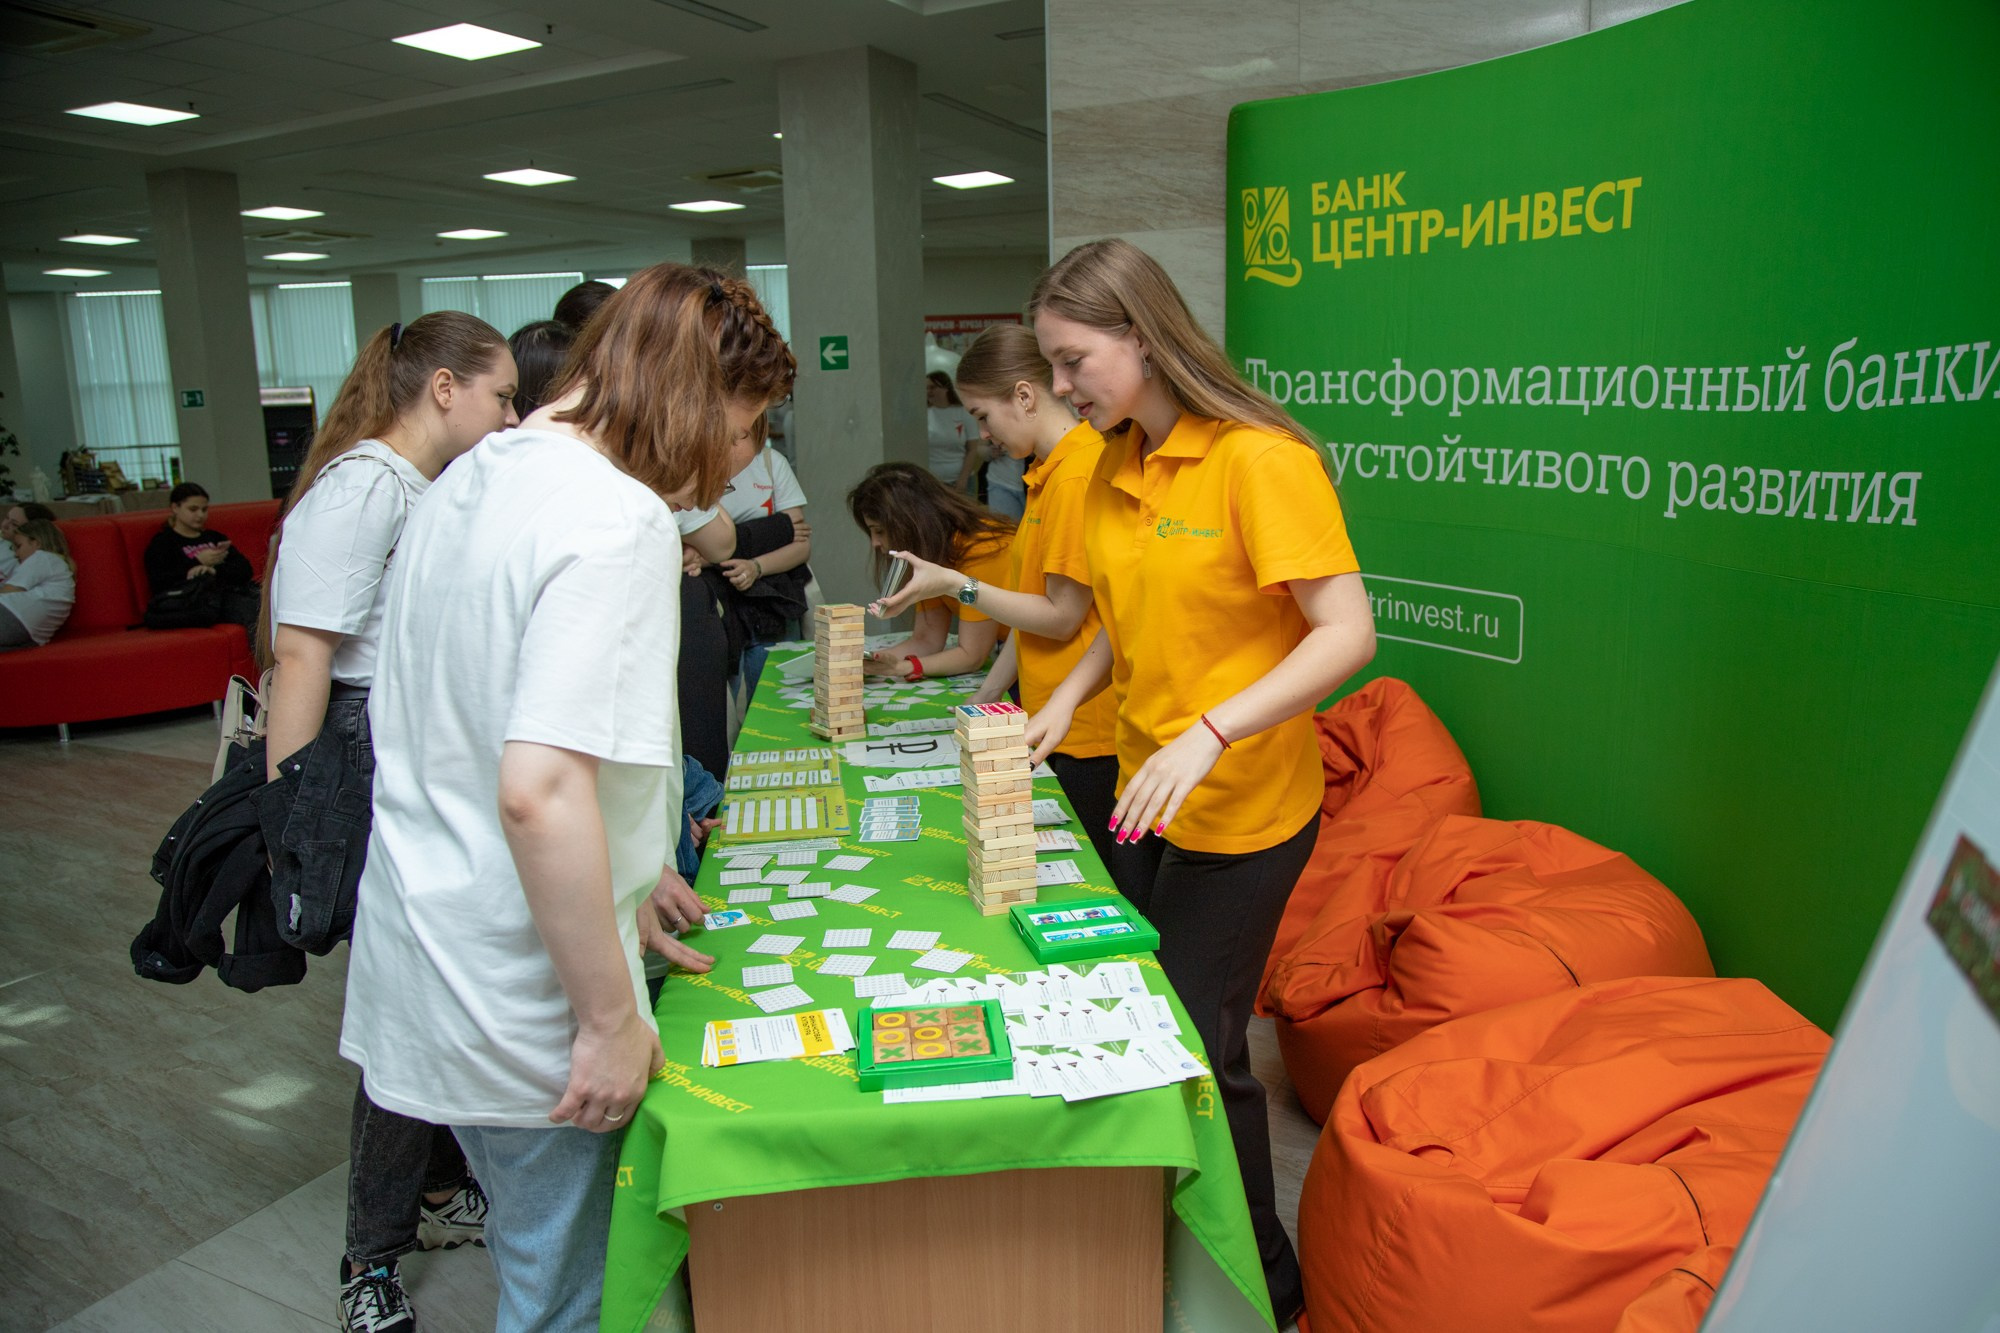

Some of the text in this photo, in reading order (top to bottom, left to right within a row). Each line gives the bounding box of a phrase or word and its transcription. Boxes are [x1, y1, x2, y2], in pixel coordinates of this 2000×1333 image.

[1311, 171, 1407, 216] БАНК
[1312, 177, 1642, 269] ЦЕНТР-ИНВЕСТ
[1245, 346, 1811, 417] Трансформационный
[1326, 434, 1922, 526] устойчивого развития
[1368, 591, 1499, 638] trinvest.ru
[656, 1067, 754, 1114] НТР-ИНВЕСТ
[800, 1057, 860, 1083] ЦЕНТР-
